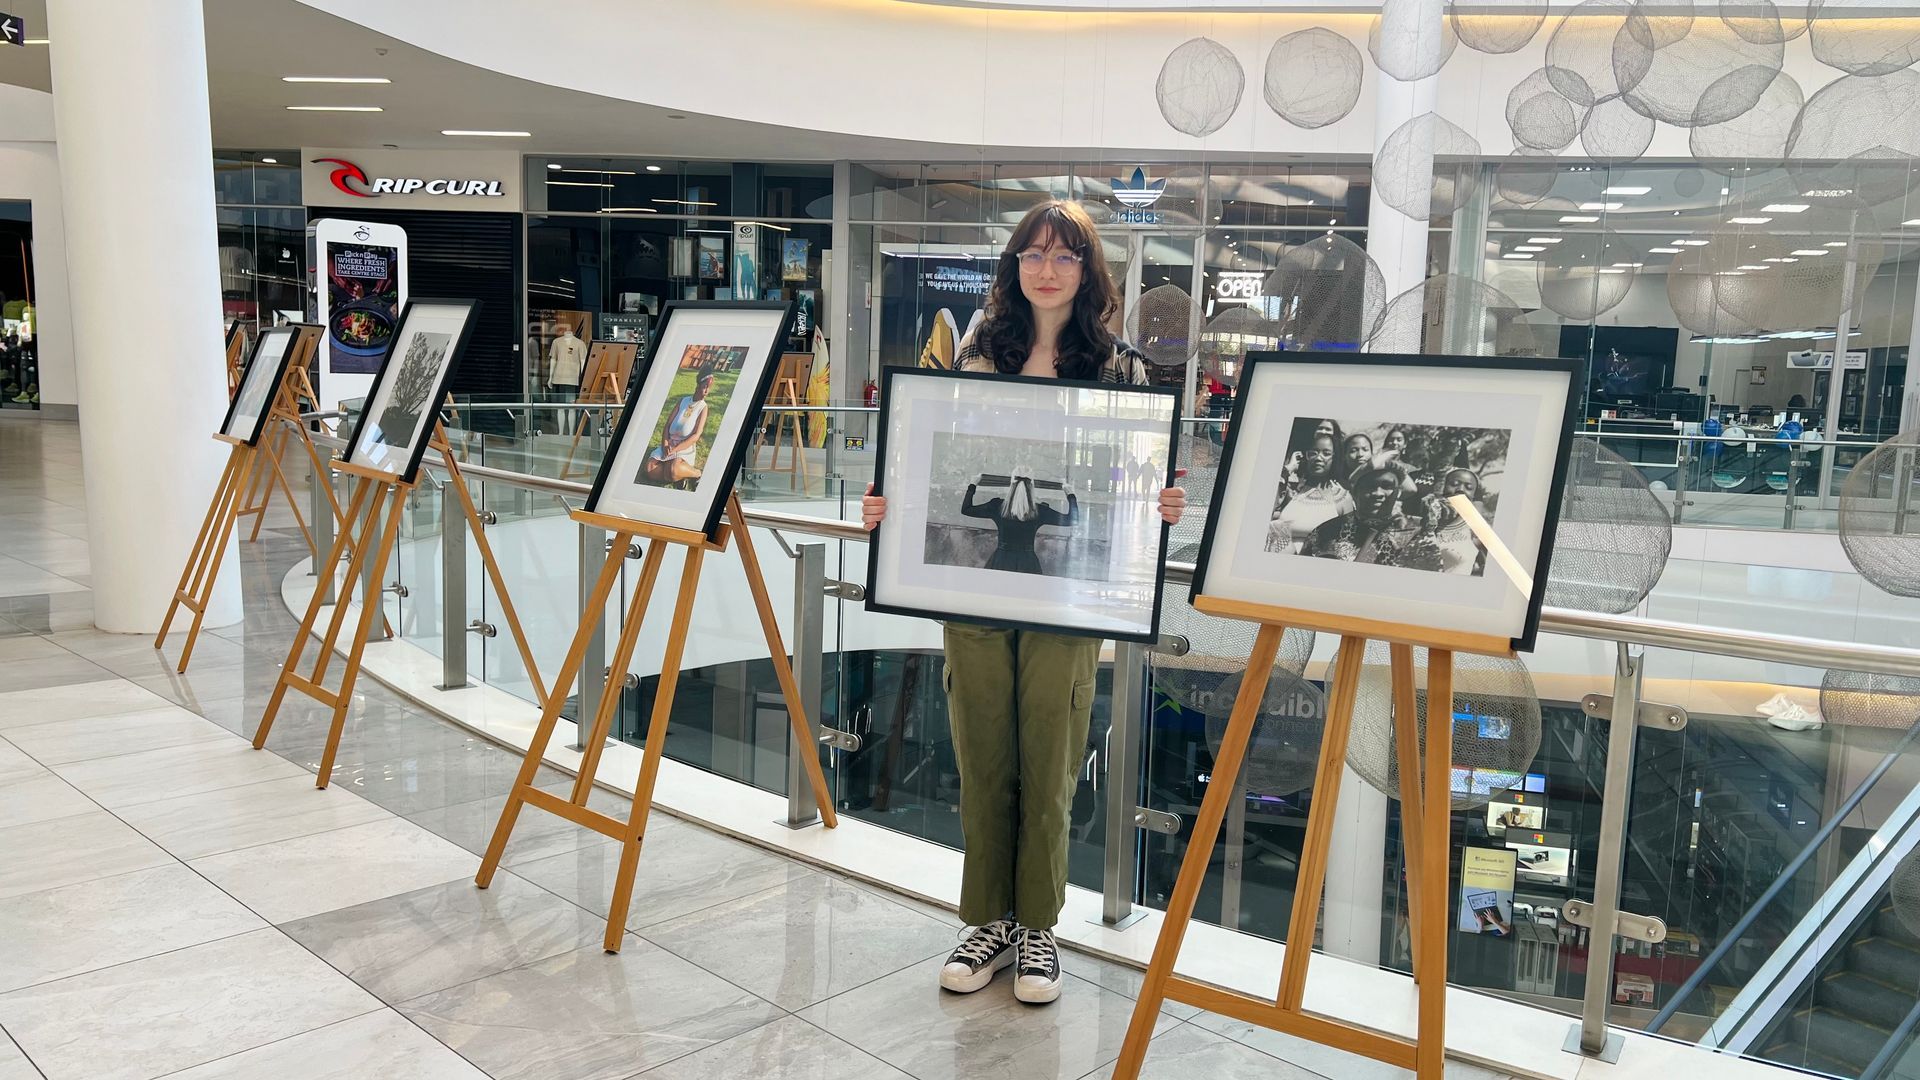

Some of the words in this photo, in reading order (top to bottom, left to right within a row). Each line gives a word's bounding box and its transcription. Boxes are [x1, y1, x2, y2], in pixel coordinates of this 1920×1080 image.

[372, 178, 424, 194] RIP
[425, 179, 505, 196] CURL
[337, 257, 363, 265] WHERE
[364, 259, 385, 267] FRESH
[337, 263, 386, 273] INGREDIENTS
[1218, 279, 1263, 297] OPEN
